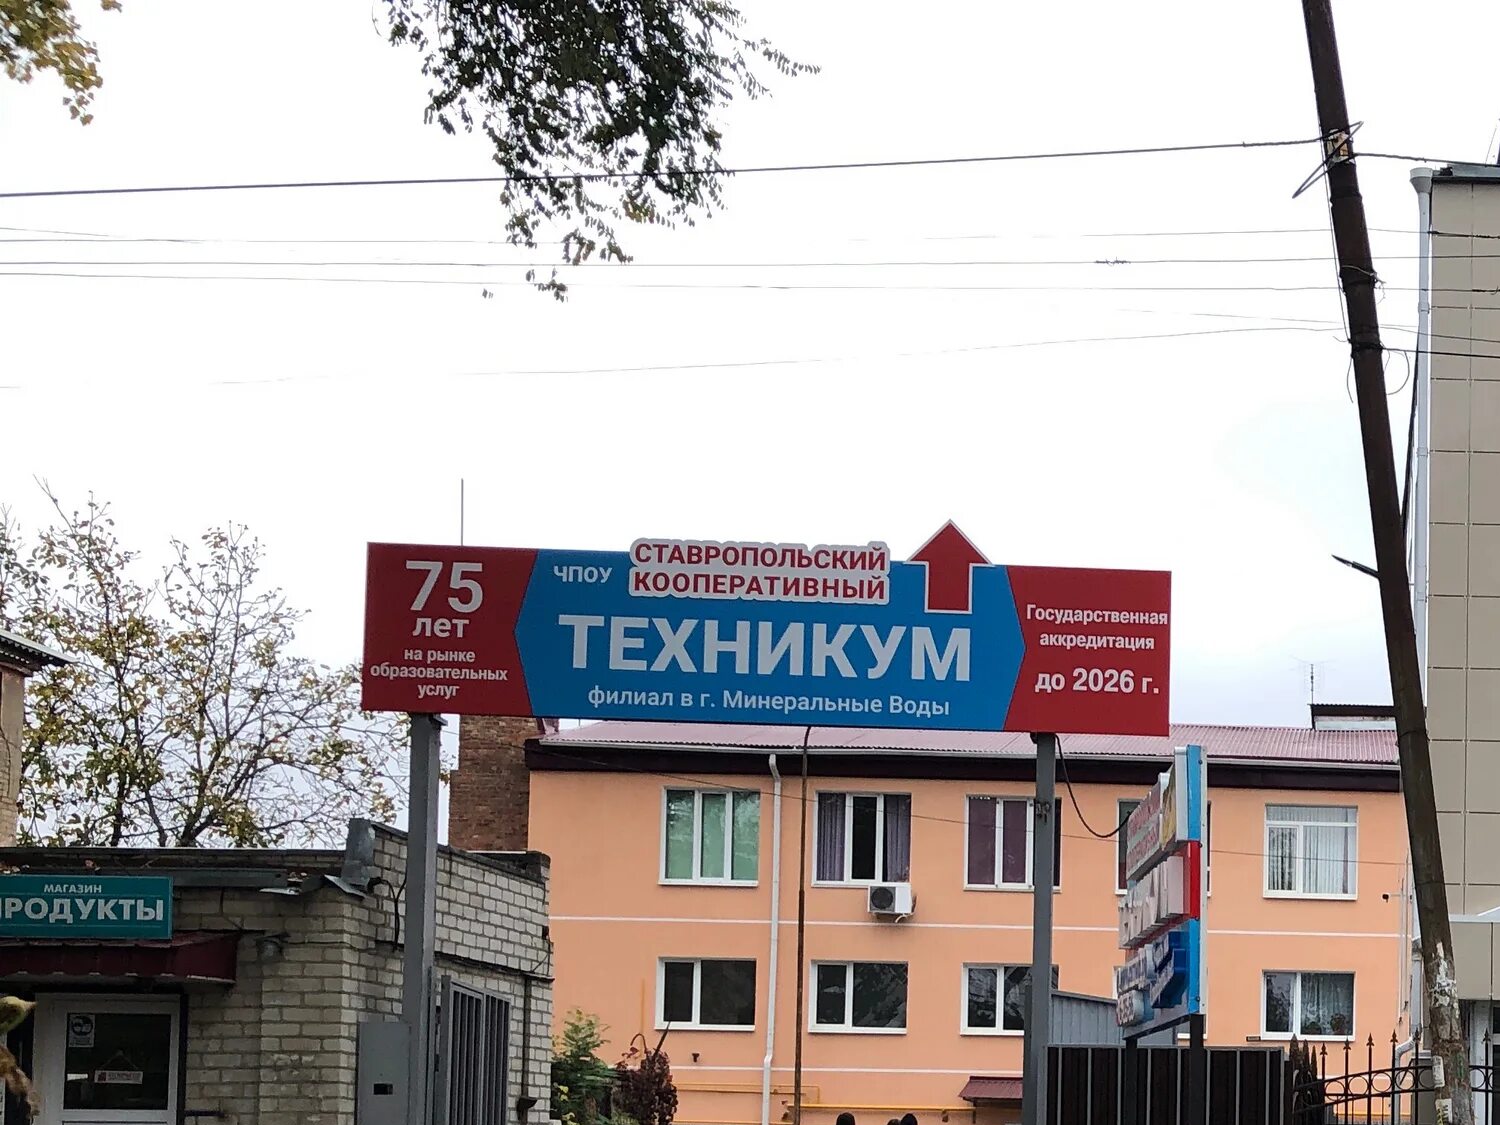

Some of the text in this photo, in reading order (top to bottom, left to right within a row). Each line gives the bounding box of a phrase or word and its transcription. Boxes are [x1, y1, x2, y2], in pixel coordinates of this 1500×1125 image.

[634, 543, 886, 571] СТАВРОПОЛЬСКИЙ
[405, 560, 484, 612] 75
[554, 566, 612, 583] ЧПОУ
[634, 572, 885, 599] КООПЕРАТИВНЫЙ
[412, 615, 469, 639] лет
[1026, 604, 1169, 626] Государственная
[558, 614, 970, 682] ТЕХНИКУМ
[1039, 632, 1155, 650] аккредитация
[404, 647, 476, 664] на рынке
[370, 663, 508, 681] образовательных
[1035, 668, 1160, 694] до 2026 г.
[417, 683, 459, 699] услуг
[588, 685, 950, 717] филиал в г. Минеральные Воды
[44, 884, 102, 893] МАГАЗИН
[0, 897, 164, 923] РОДУКТЫ
